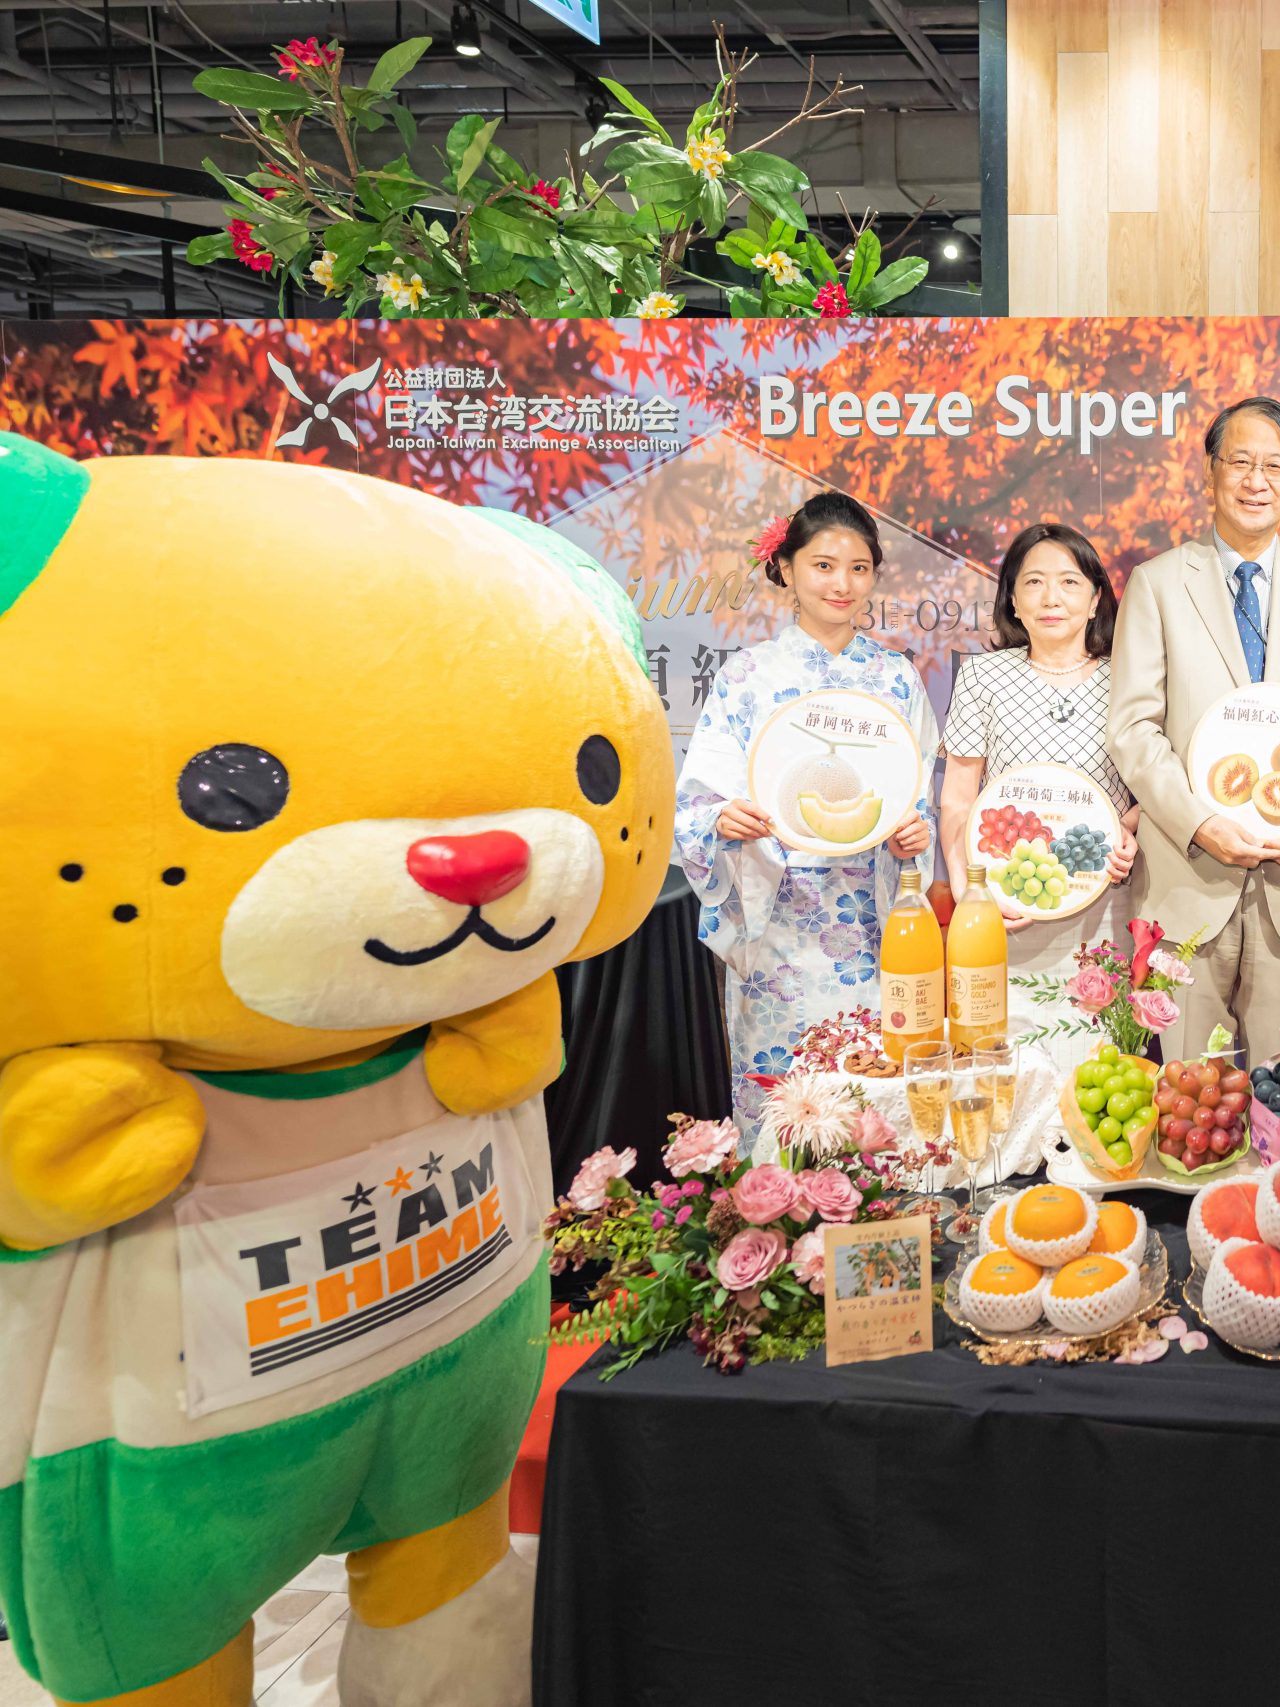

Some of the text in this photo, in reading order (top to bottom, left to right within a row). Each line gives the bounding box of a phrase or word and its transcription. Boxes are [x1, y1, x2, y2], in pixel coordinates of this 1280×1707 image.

[383, 367, 507, 390] 公益財団法人
[384, 394, 680, 433] 日本台湾交流協会
[759, 375, 1187, 455] Breeze Super
[387, 435, 682, 452] Japan-Taiwan Exchange Association
[805, 711, 888, 739] 靜岡哈密瓜
[238, 1141, 495, 1292] TEAM
[245, 1184, 504, 1348] EHIME
